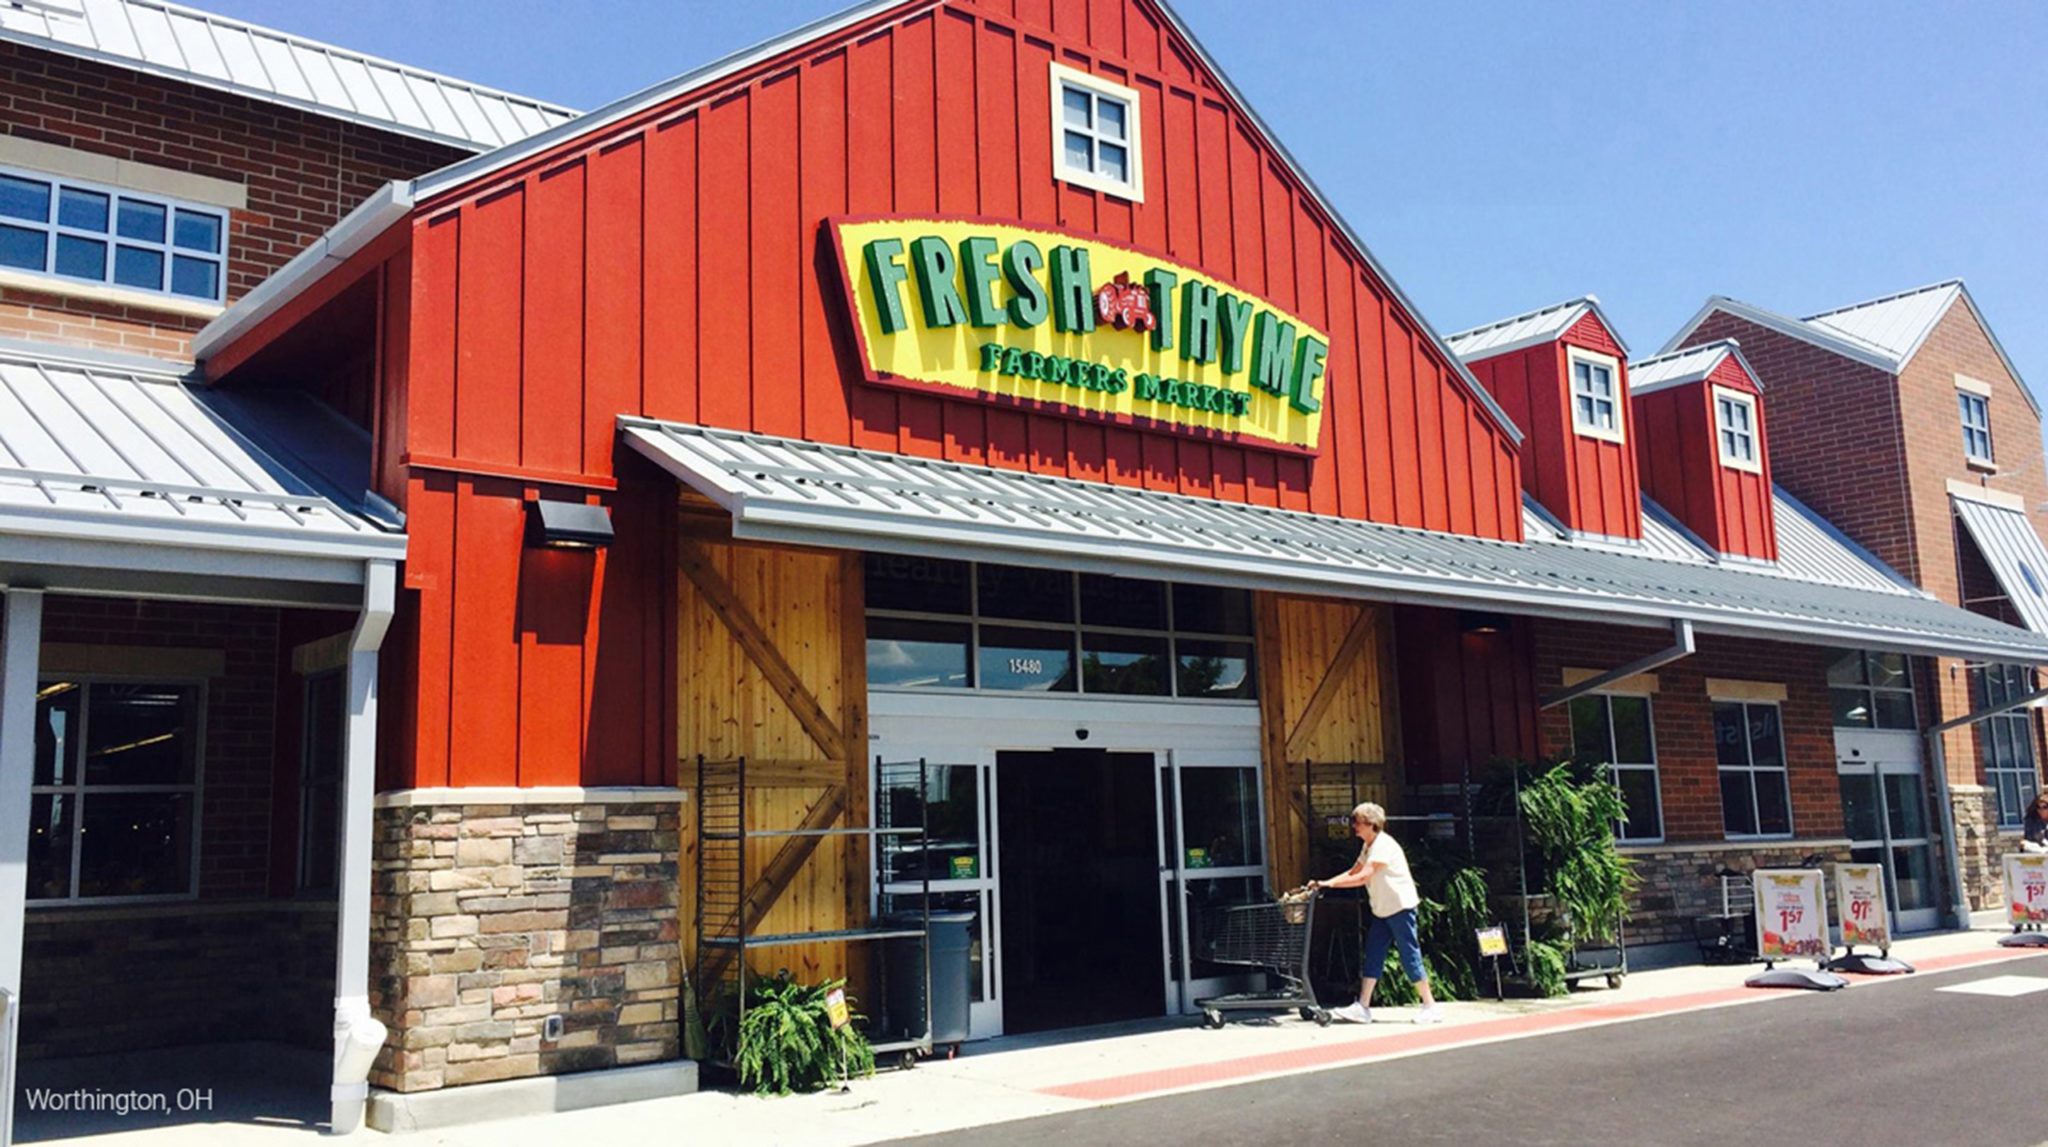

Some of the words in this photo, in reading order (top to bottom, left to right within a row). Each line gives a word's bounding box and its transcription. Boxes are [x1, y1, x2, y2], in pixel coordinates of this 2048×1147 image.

[863, 235, 1097, 334] FRESH
[1145, 267, 1328, 415] THYME
[979, 342, 1128, 395] FARMERS
[1135, 373, 1252, 417] MARKET
[1009, 658, 1042, 674] 15480
